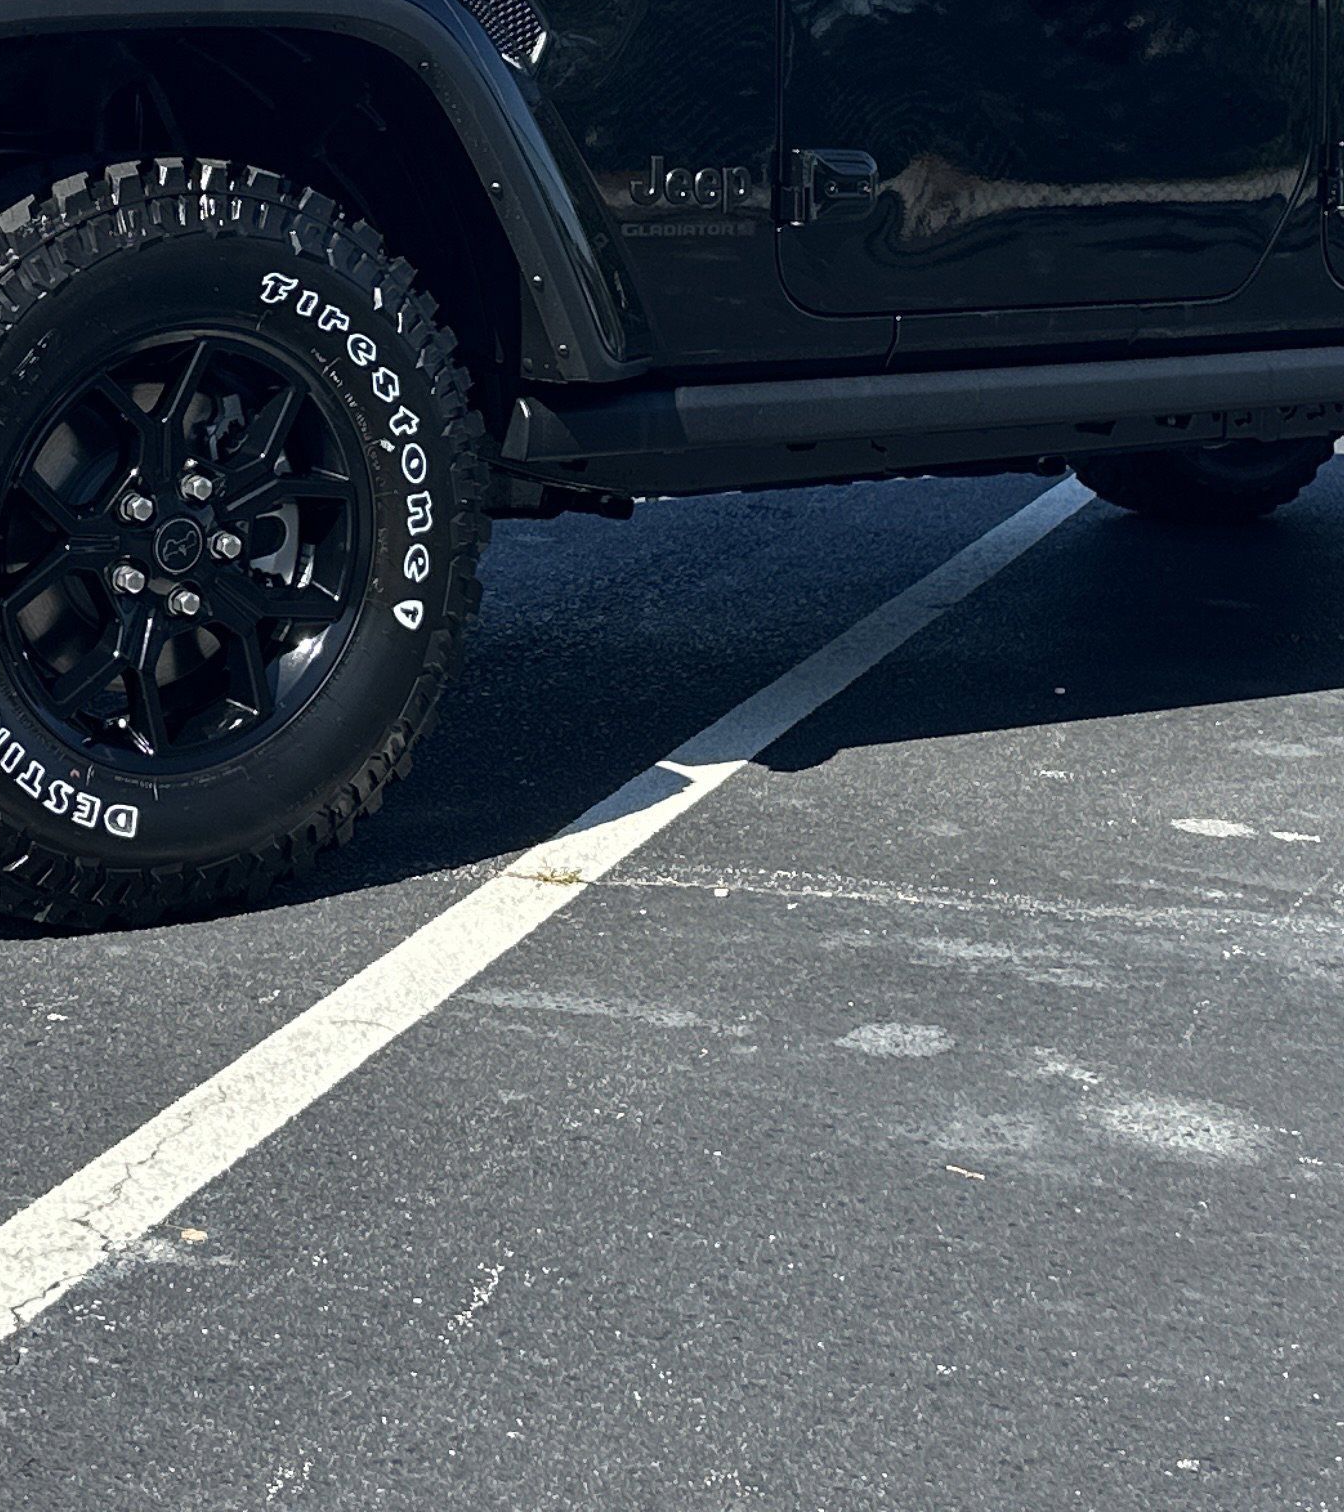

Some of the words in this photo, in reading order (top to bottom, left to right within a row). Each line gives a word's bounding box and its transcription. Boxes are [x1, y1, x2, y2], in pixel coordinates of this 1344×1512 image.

[630, 155, 752, 214] Jeep
[620, 223, 734, 237] GLADIATOR
[259, 272, 433, 583] Firestone
